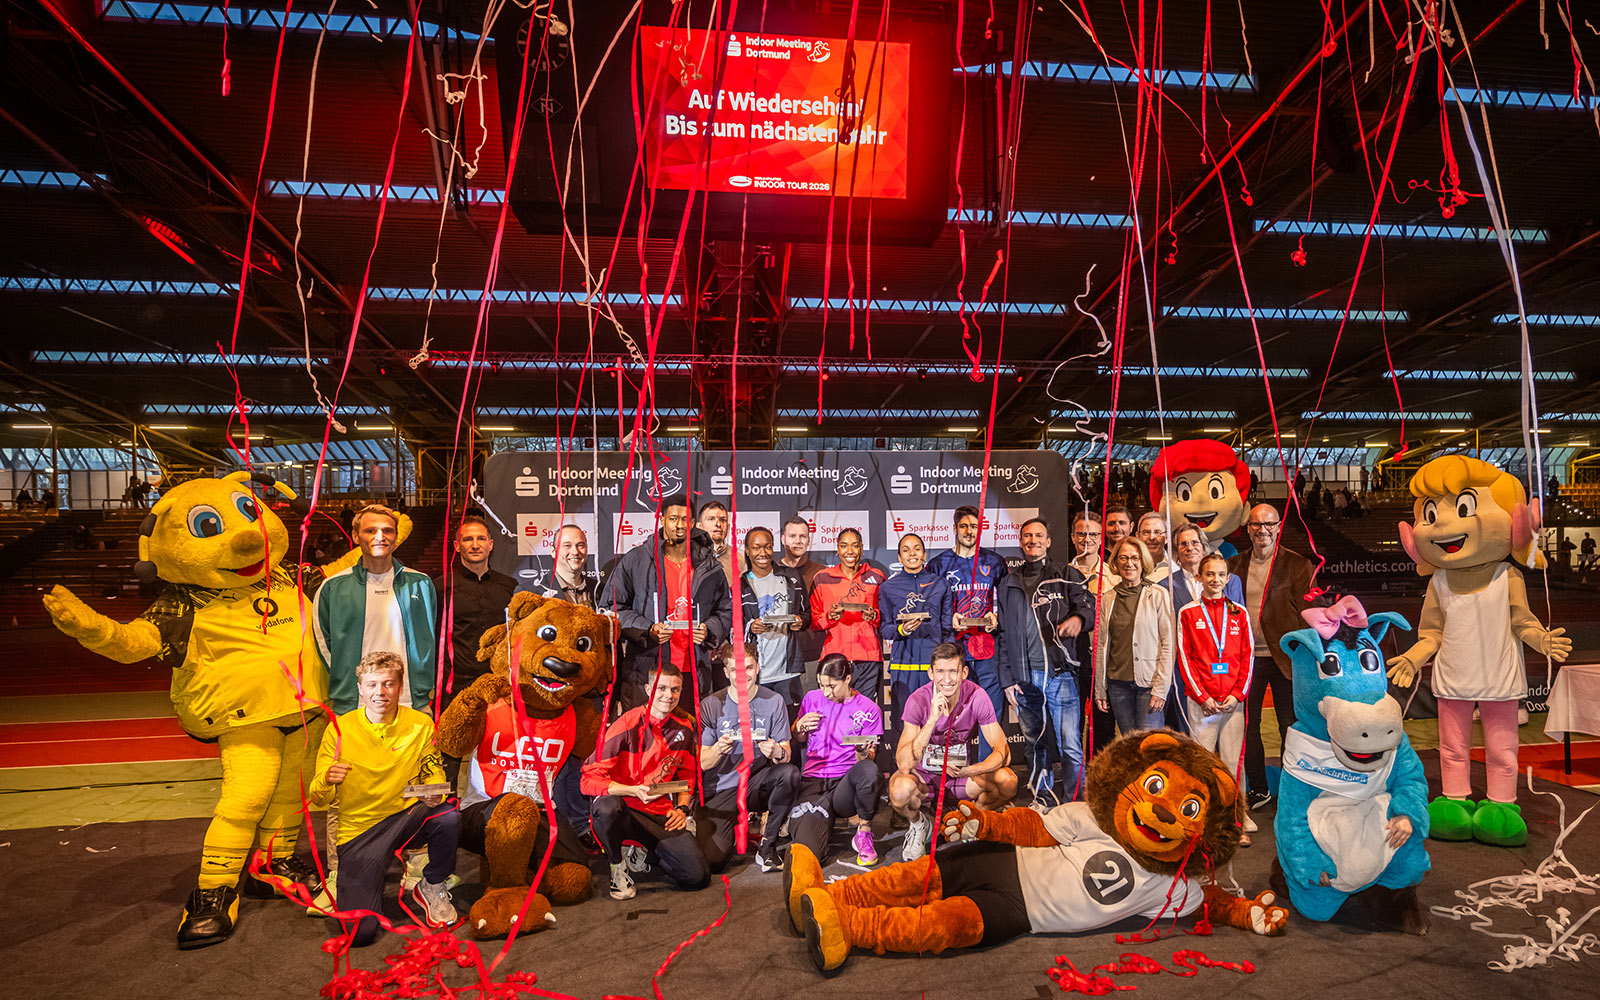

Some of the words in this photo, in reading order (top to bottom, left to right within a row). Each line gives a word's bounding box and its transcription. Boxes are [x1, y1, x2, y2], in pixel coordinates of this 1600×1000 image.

[746, 36, 775, 47] Indoor
[776, 38, 811, 51] Meeting
[746, 48, 790, 60] Dortmund
[688, 89, 725, 110] Auf
[666, 114, 698, 136] Bis
[751, 120, 838, 142] nächsten
[754, 181, 785, 189] INDOOR
[786, 182, 808, 190] TOUR
[548, 467, 593, 480] Indoor
[741, 466, 784, 479] Indoor
[787, 466, 840, 481] Meeting
[920, 465, 960, 478] Indoor
[742, 483, 808, 495] Dortmund
[920, 481, 982, 494] Dortmund
[908, 524, 949, 533] Sparkasse
[491, 757, 558, 774] DORMND
[1089, 859, 1129, 898] 21
